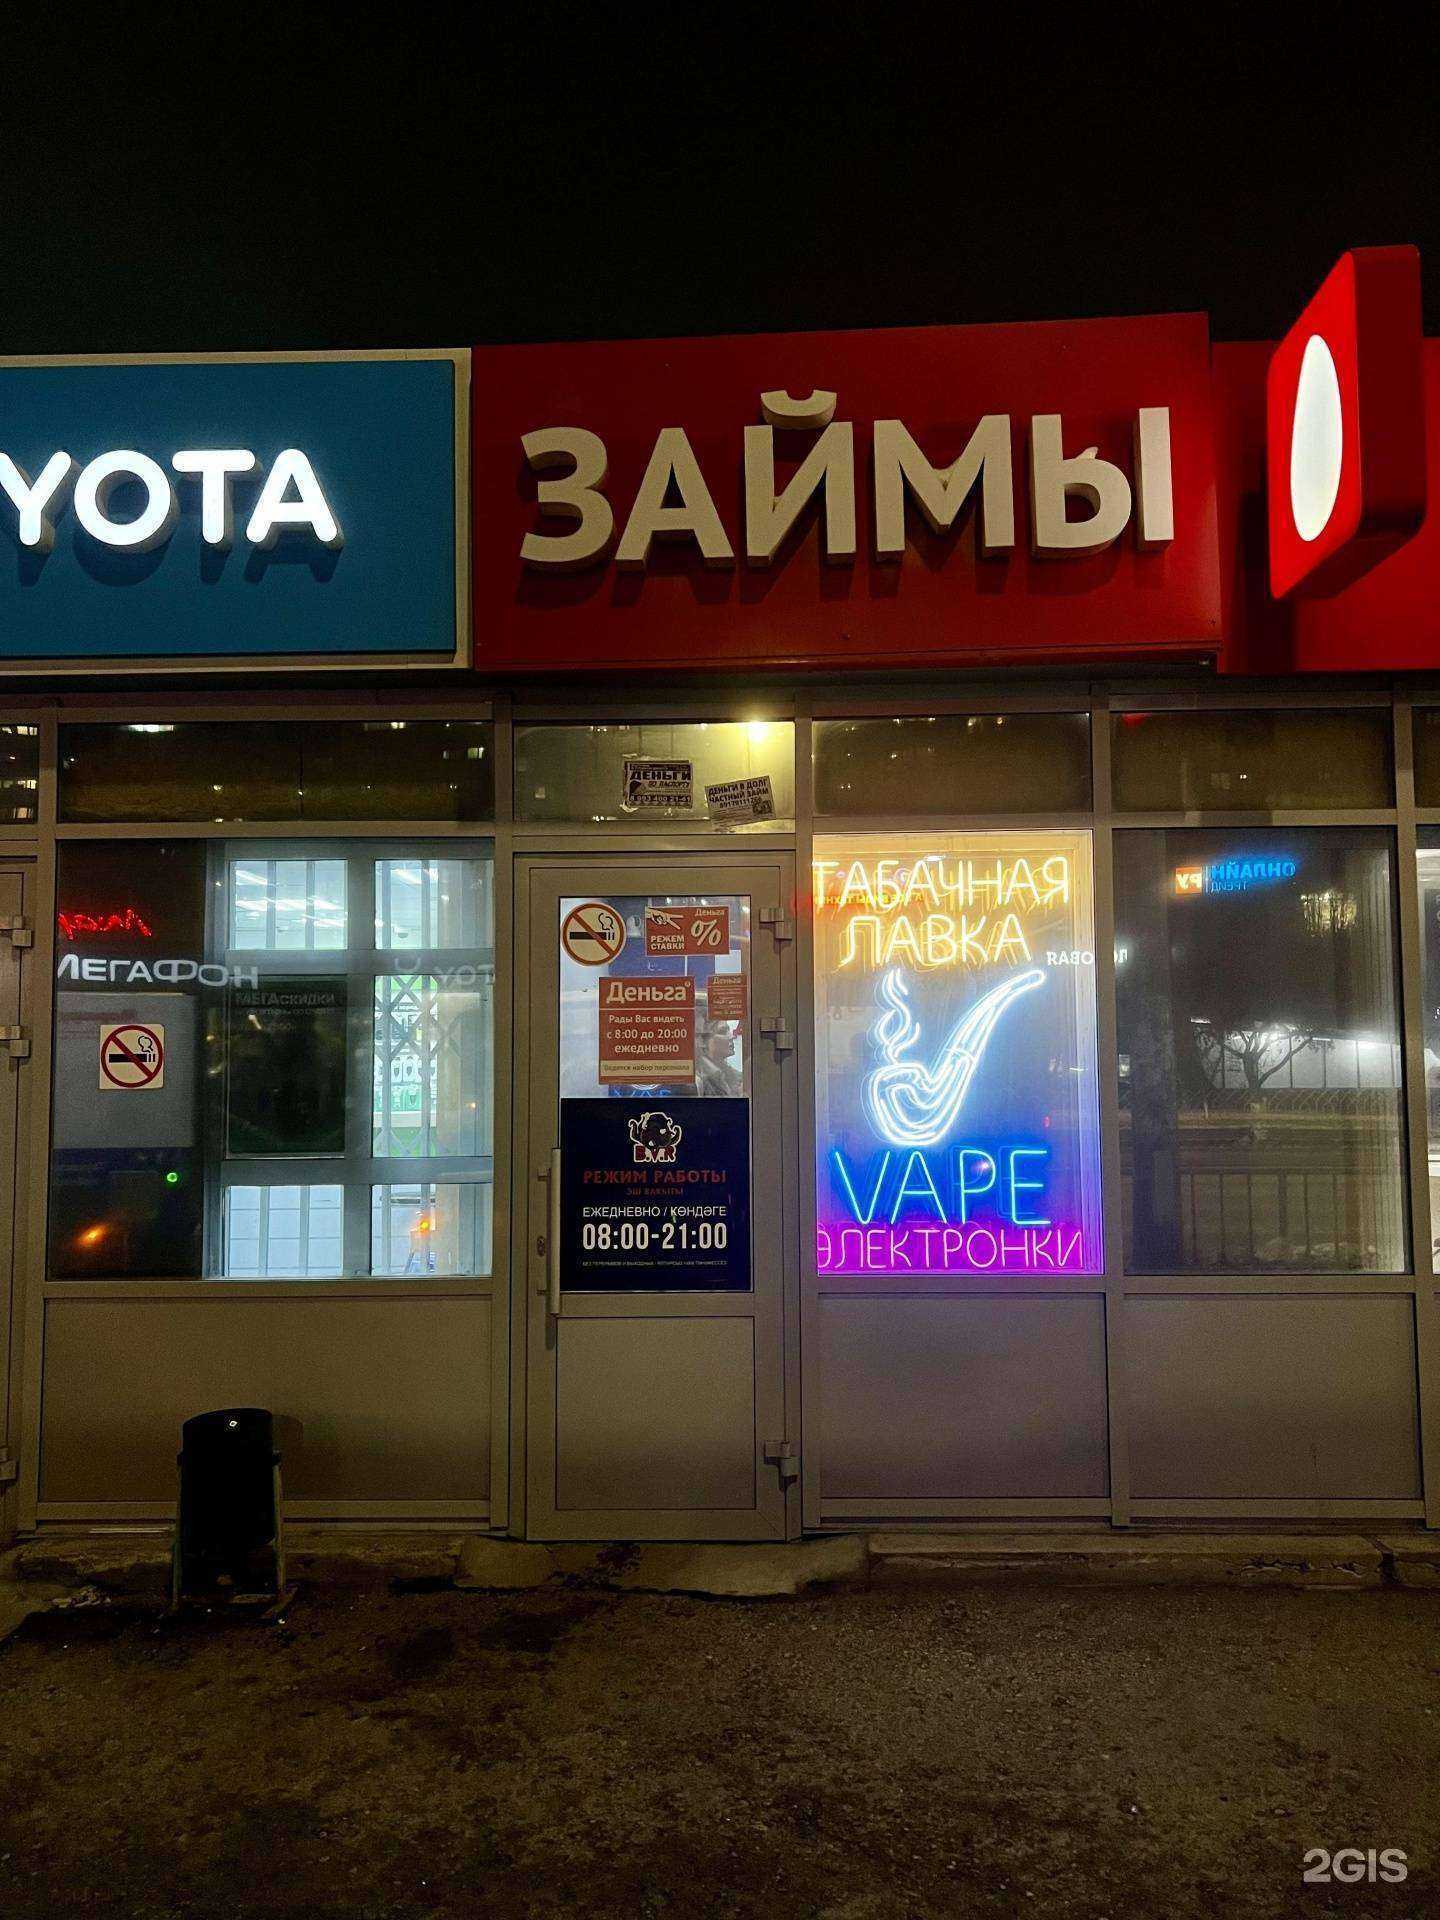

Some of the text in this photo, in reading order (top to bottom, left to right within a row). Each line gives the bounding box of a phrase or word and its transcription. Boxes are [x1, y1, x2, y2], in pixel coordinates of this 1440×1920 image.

[519, 389, 1174, 566] ЗАЙМЫ
[0, 449, 338, 546] YOTA
[630, 771, 691, 780] ДЕНЬГИ
[708, 779, 768, 797] ДЕНЬГИ В ДОЛГ
[708, 786, 769, 803] ЧАСТНЫЙ ЗАЙМ
[811, 856, 1070, 909] ТАБАЧНАЯ
[650, 934, 685, 943] РЕЖЕМ
[650, 942, 685, 950] СТАВКИ
[838, 913, 1033, 967] ЛАВКА
[606, 981, 687, 1004] Деньга
[609, 1014, 685, 1024] Рады Вас видеть
[606, 1028, 687, 1040] с 8:00 до 20:00
[614, 1044, 680, 1055] ежедневно
[632, 1064, 653, 1072] набор
[583, 1170, 726, 1184] РЕЖИМ РАБОТЫ
[834, 1150, 1051, 1225] VAPE
[582, 1206, 661, 1218] ЕЖЕДНЕВНО
[582, 1222, 727, 1250] 08:00-21:00
[817, 1229, 1084, 1268] ЭЛЕКТРОНКИ
